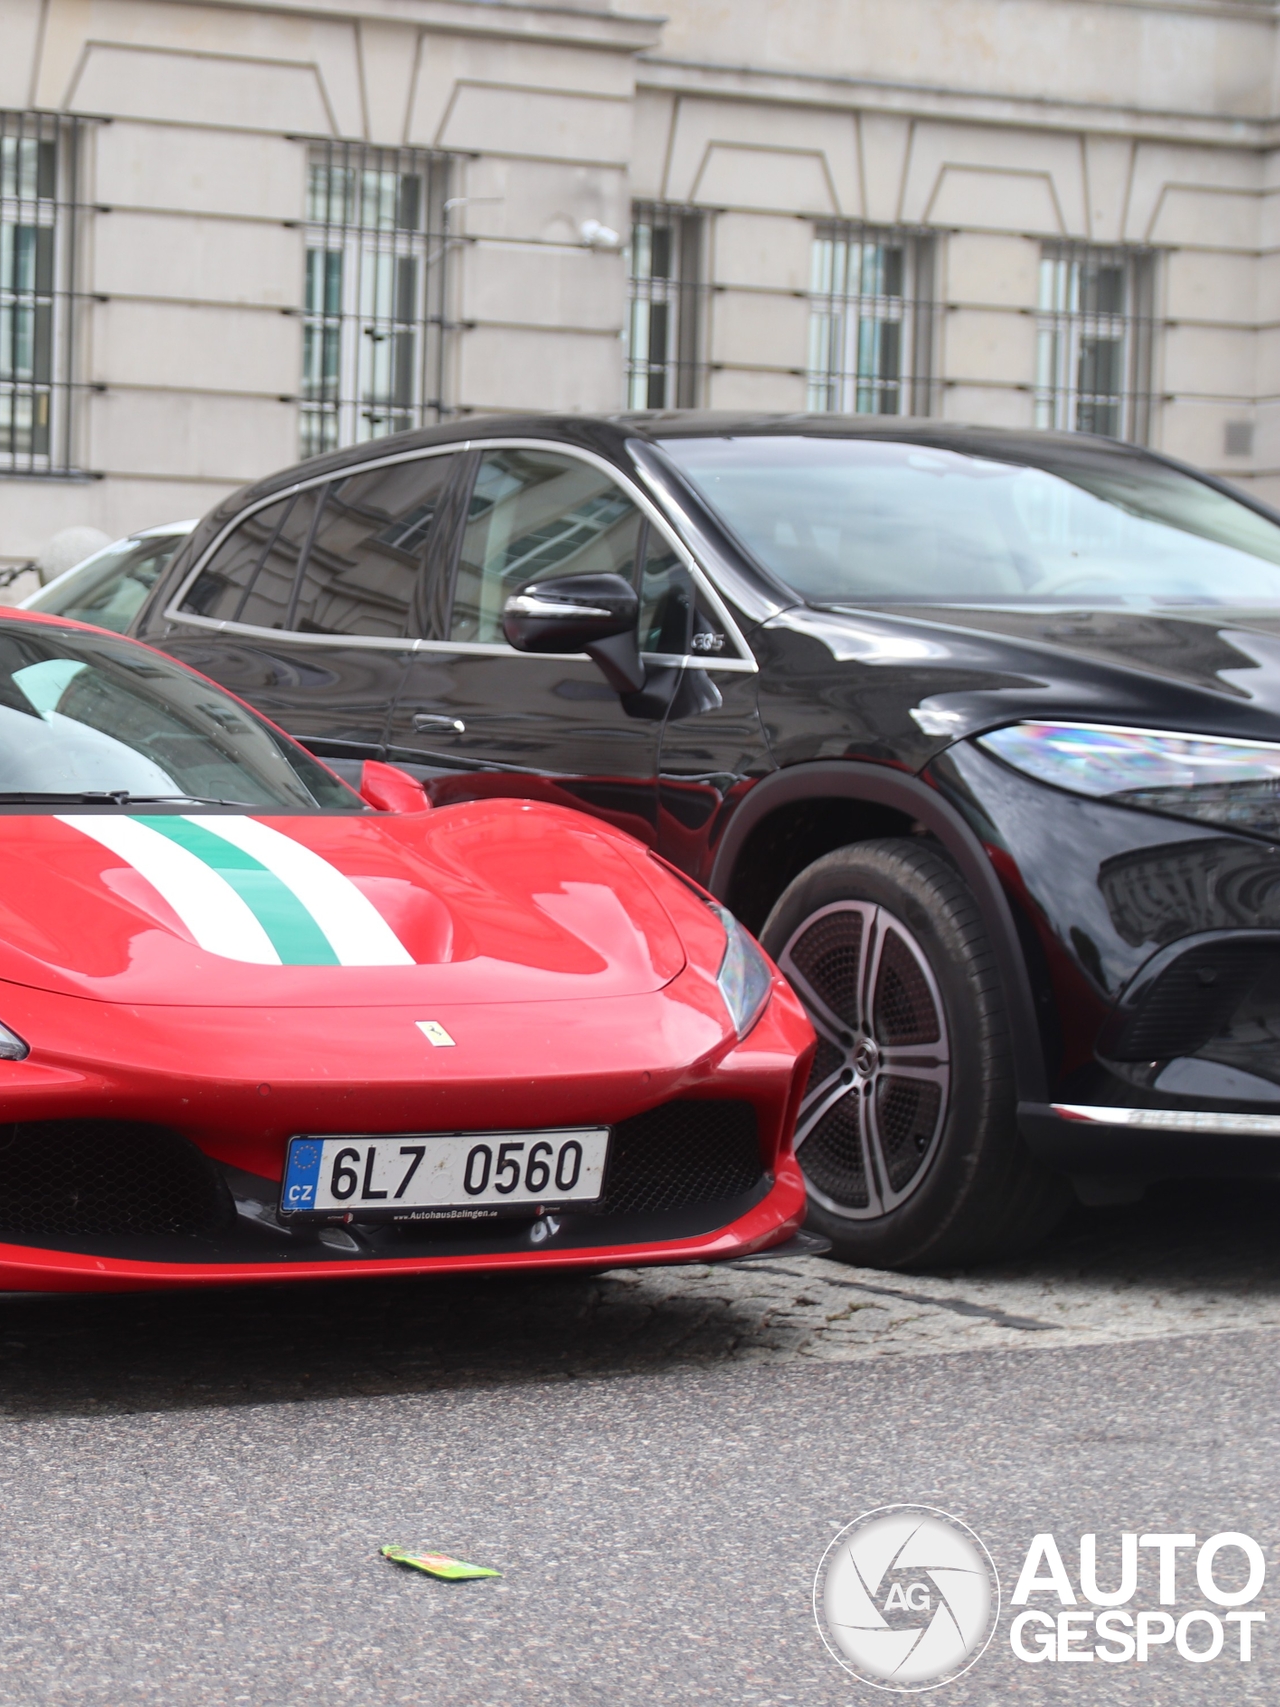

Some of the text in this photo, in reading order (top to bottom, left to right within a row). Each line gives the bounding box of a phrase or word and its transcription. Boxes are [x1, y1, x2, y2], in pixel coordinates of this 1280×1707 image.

[329, 1139, 583, 1201] 6L7 0560
[288, 1184, 313, 1202] CZ
[393, 1209, 498, 1220] www.AutohausBalingen.de
